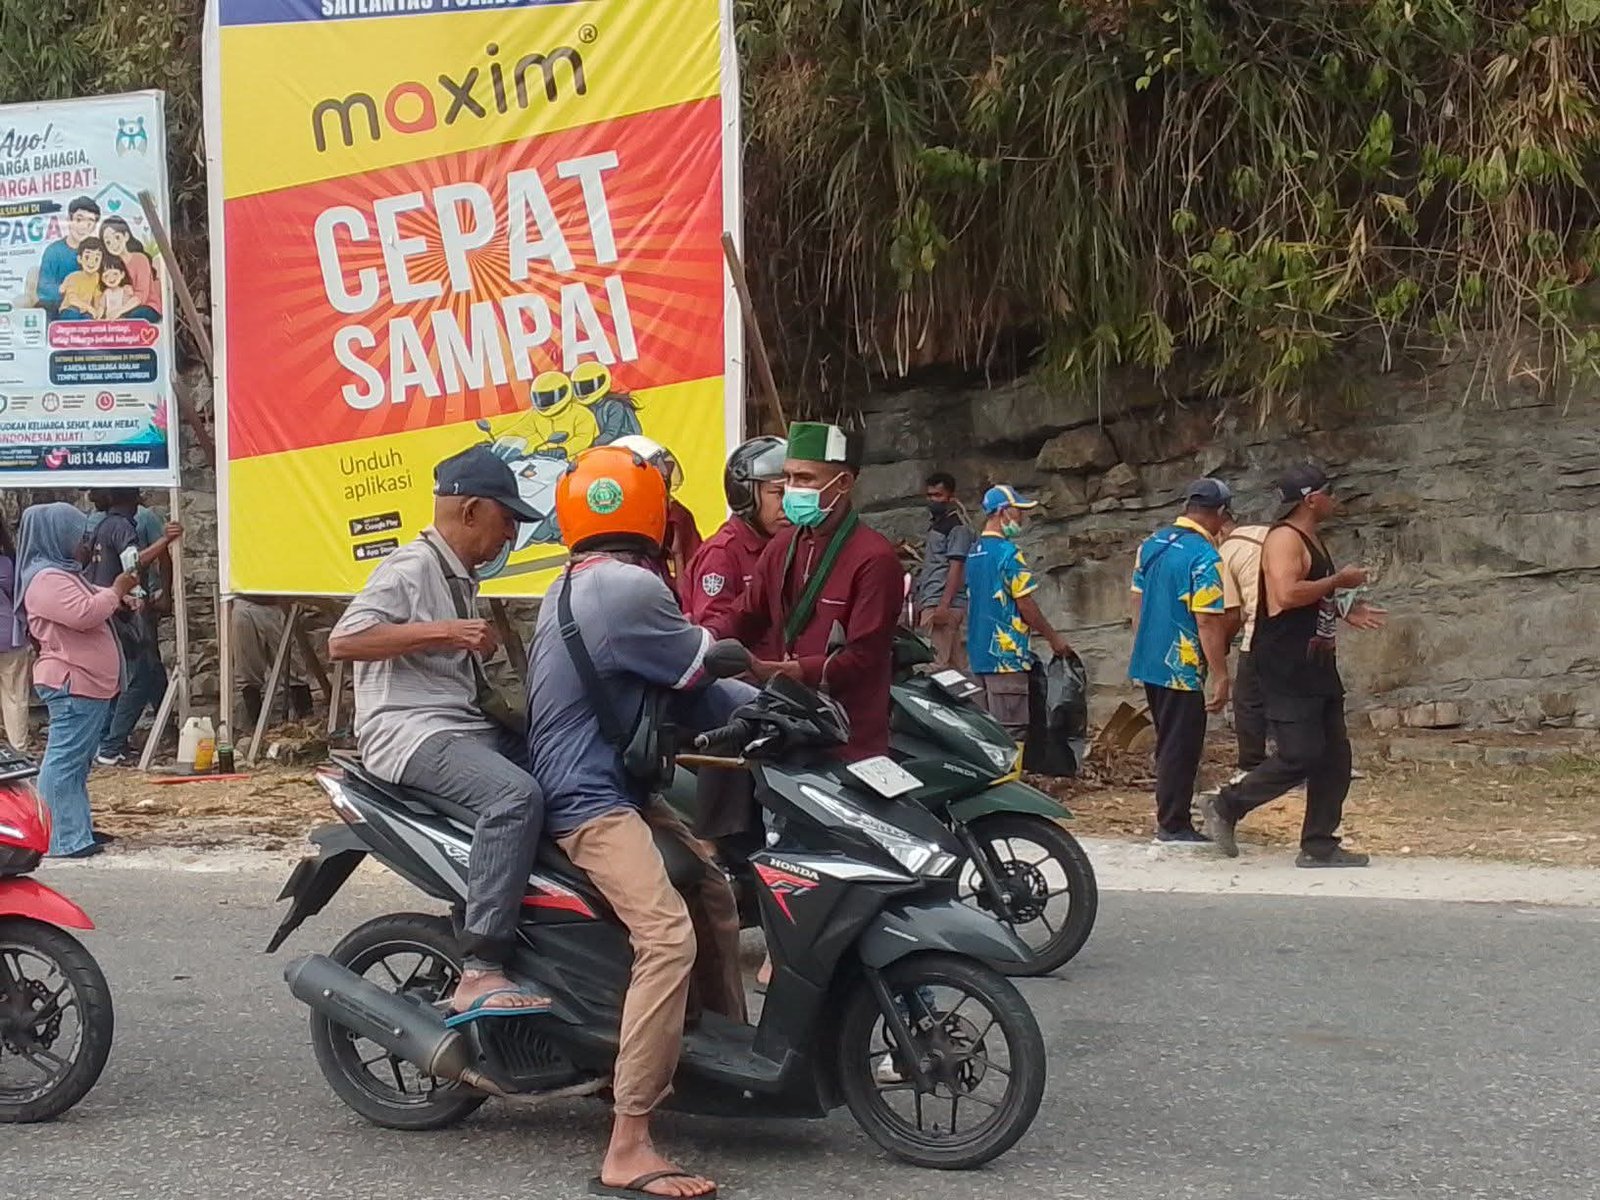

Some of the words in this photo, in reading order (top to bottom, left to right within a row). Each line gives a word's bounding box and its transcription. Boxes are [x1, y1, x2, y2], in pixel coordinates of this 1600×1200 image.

[0, 122, 53, 158] Ayo!
[34, 149, 89, 171] BAHAGIA,
[42, 167, 97, 193] HEBAT!
[313, 150, 619, 313] CEPAT
[333, 275, 639, 410] SAMPAI
[28, 420, 65, 430] KELUARGA
[66, 420, 90, 430] SEHAT,
[92, 420, 113, 429] ANAK
[115, 419, 140, 429] HEBAT,
[55, 431, 84, 442] KUAT!
[67, 452, 94, 465] 0813
[96, 451, 122, 465] 4406
[340, 448, 403, 476] Unduh
[344, 469, 413, 502] aplikasi
[943, 762, 978, 779] HONDA
[770, 857, 820, 881] HONDA
